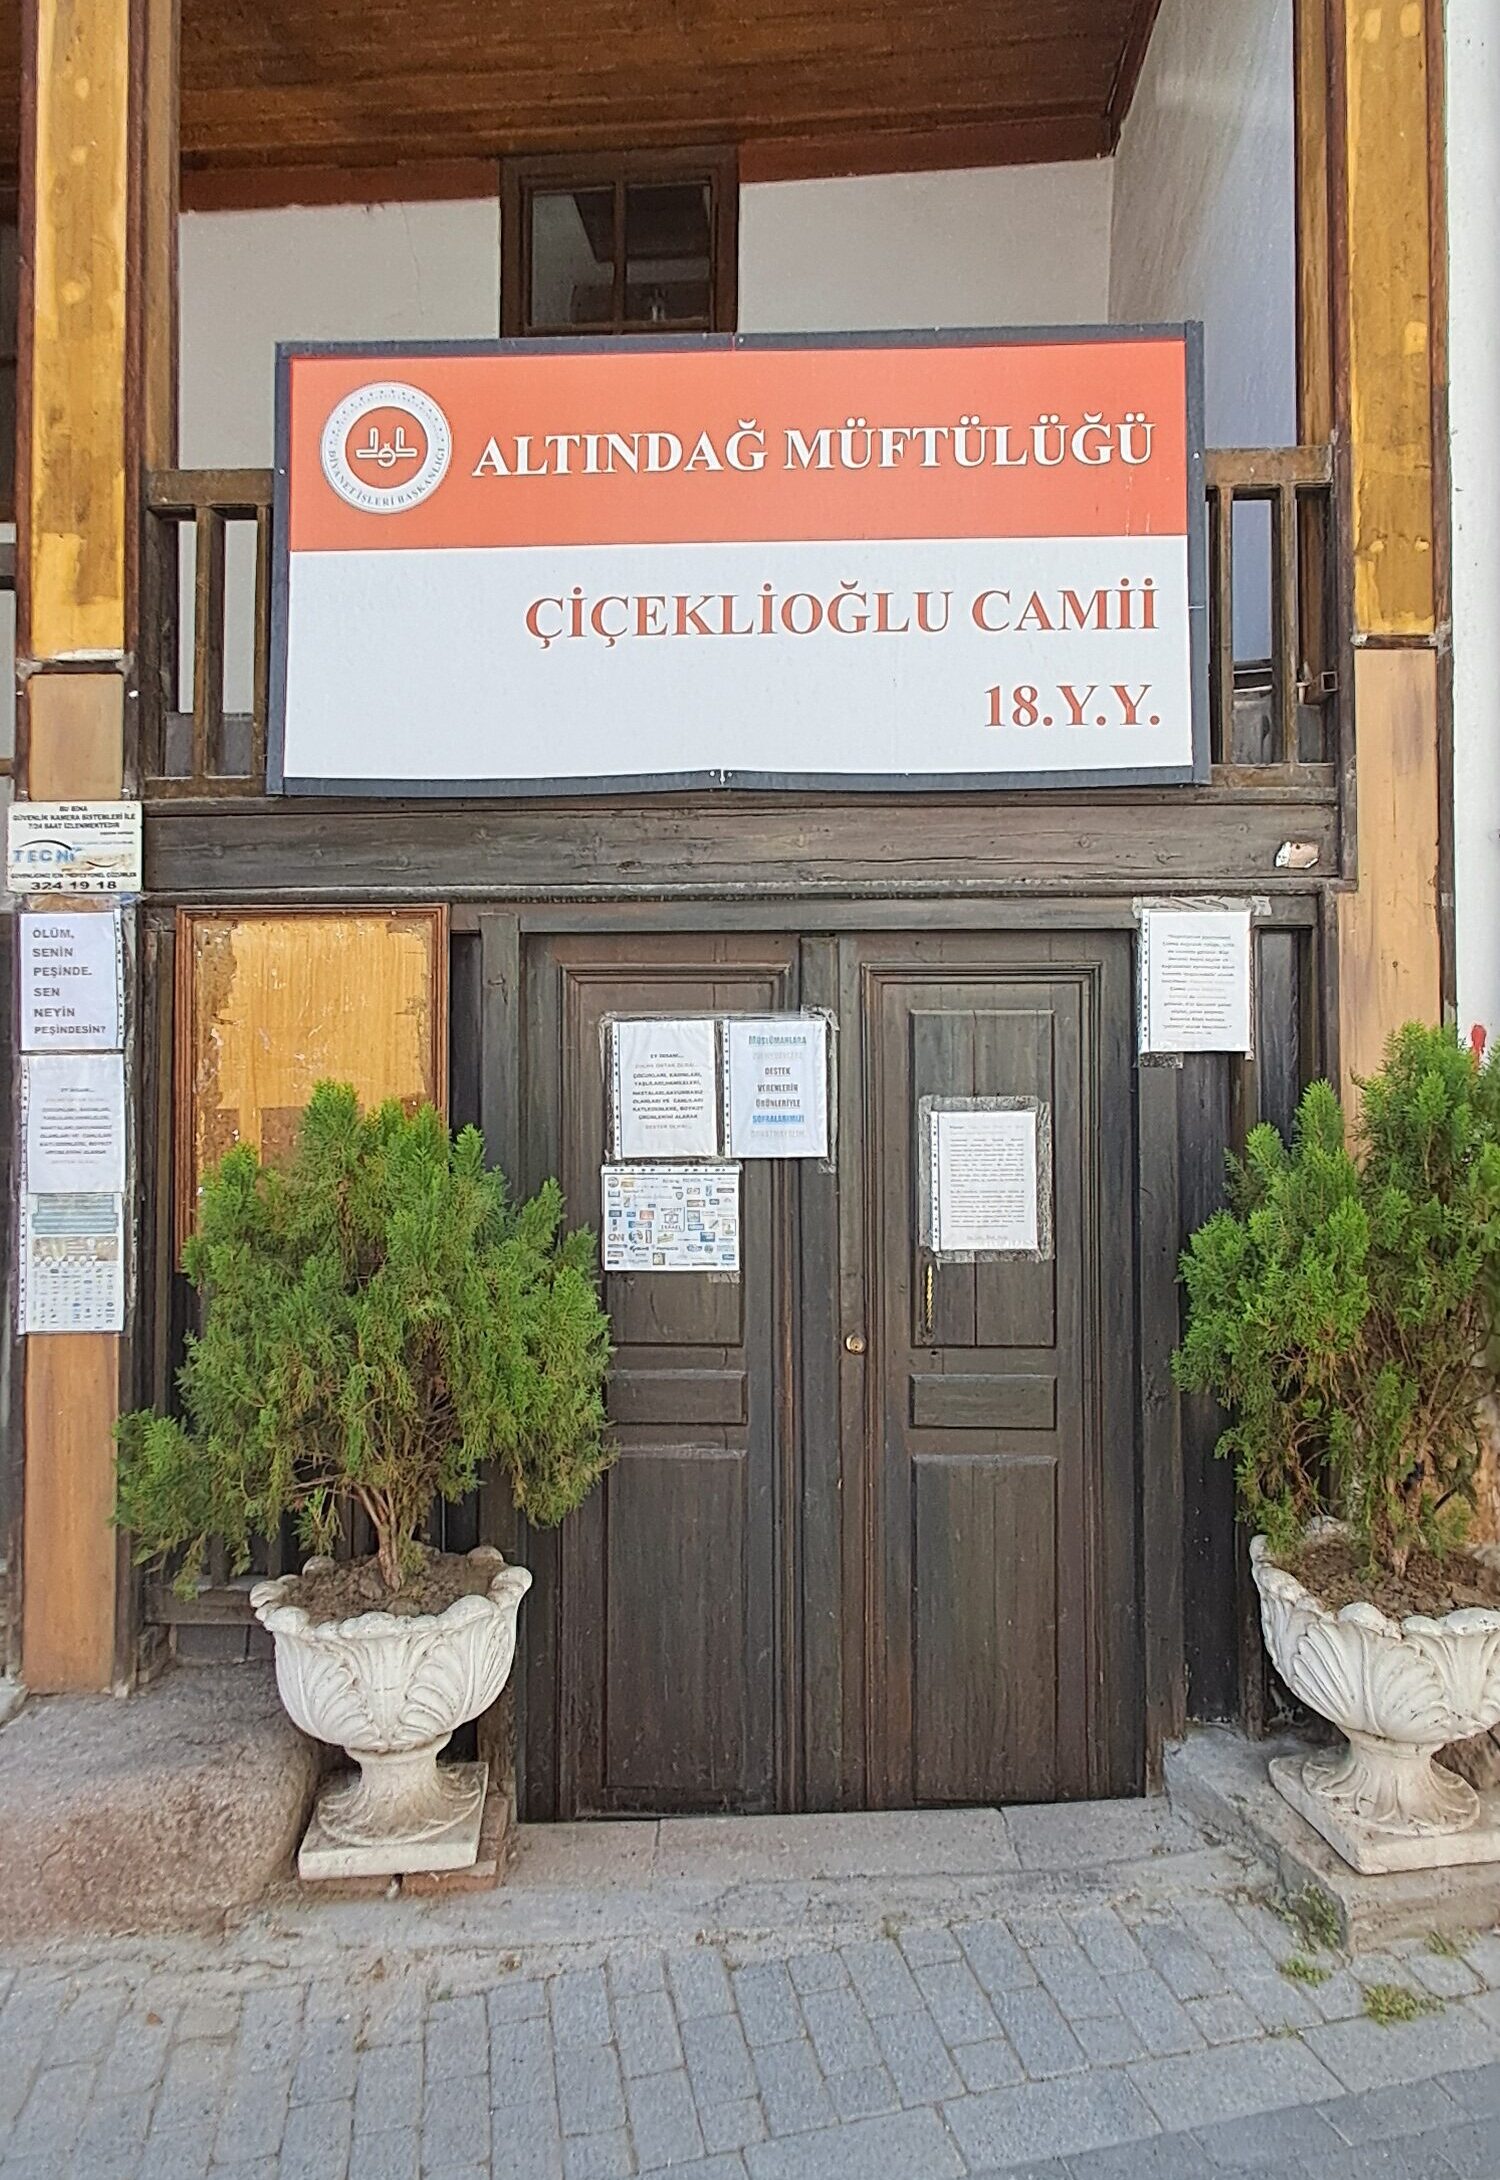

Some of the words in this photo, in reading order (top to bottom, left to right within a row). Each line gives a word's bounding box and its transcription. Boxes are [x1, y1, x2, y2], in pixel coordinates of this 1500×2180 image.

[472, 418, 768, 477] ALTINDAĞ
[783, 411, 1155, 470] MÜFTÜLÜĞÜ
[525, 580, 953, 649] ÇİÇEKLİOĞLU
[972, 577, 1160, 631] CAMİİ
[984, 684, 1160, 727] 18.Y.Y.
[31, 881, 63, 890] 324
[68, 880, 91, 890] 19
[96, 880, 117, 890] 18
[32, 927, 75, 940] ÖLÜM,
[32, 946, 74, 958] SENİN
[33, 964, 93, 979] PEŞİNDE.
[33, 987, 61, 997] SEN
[33, 1005, 75, 1018] NEYİN
[34, 1023, 107, 1036] PEŞİNDESİN?
[764, 1067, 791, 1075] DESTEK
